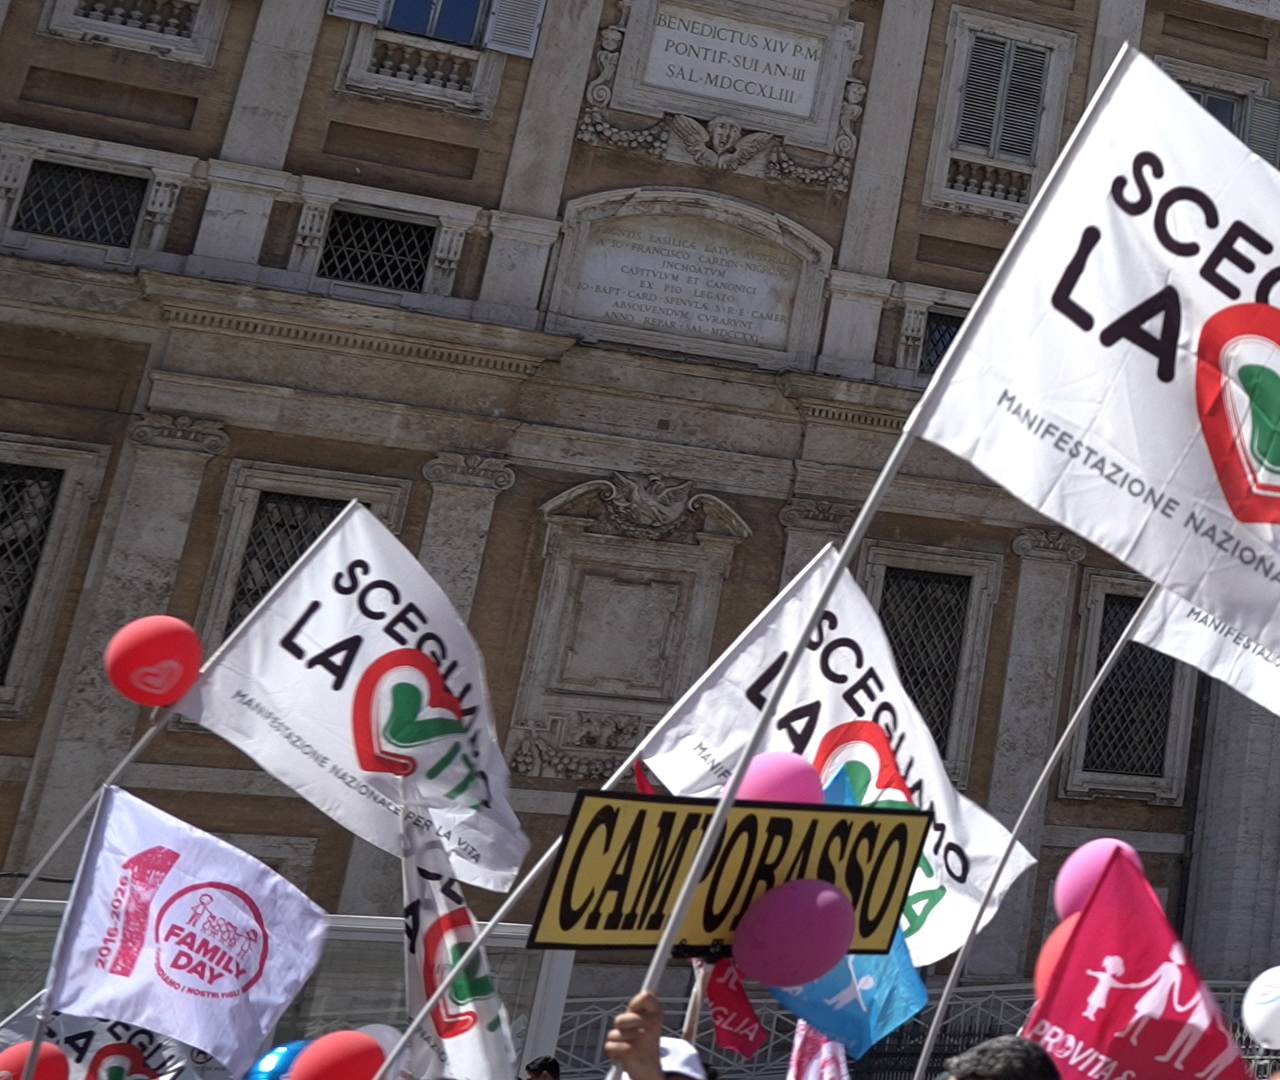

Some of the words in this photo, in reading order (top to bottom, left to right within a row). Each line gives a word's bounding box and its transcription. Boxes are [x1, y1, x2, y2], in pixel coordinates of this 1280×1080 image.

[655, 13, 759, 48] BENEDICTUS
[762, 37, 789, 54] XIV
[1051, 225, 1181, 383] LA
[997, 389, 1180, 519] MANIFESTAZIONE
[279, 600, 363, 691] LA
[331, 764, 404, 815] NAZIONALE
[405, 810, 434, 831] PER
[436, 823, 454, 841] LA
[457, 836, 483, 864] VITA
[164, 924, 247, 980] FAMILY
[169, 950, 225, 985] DAY
